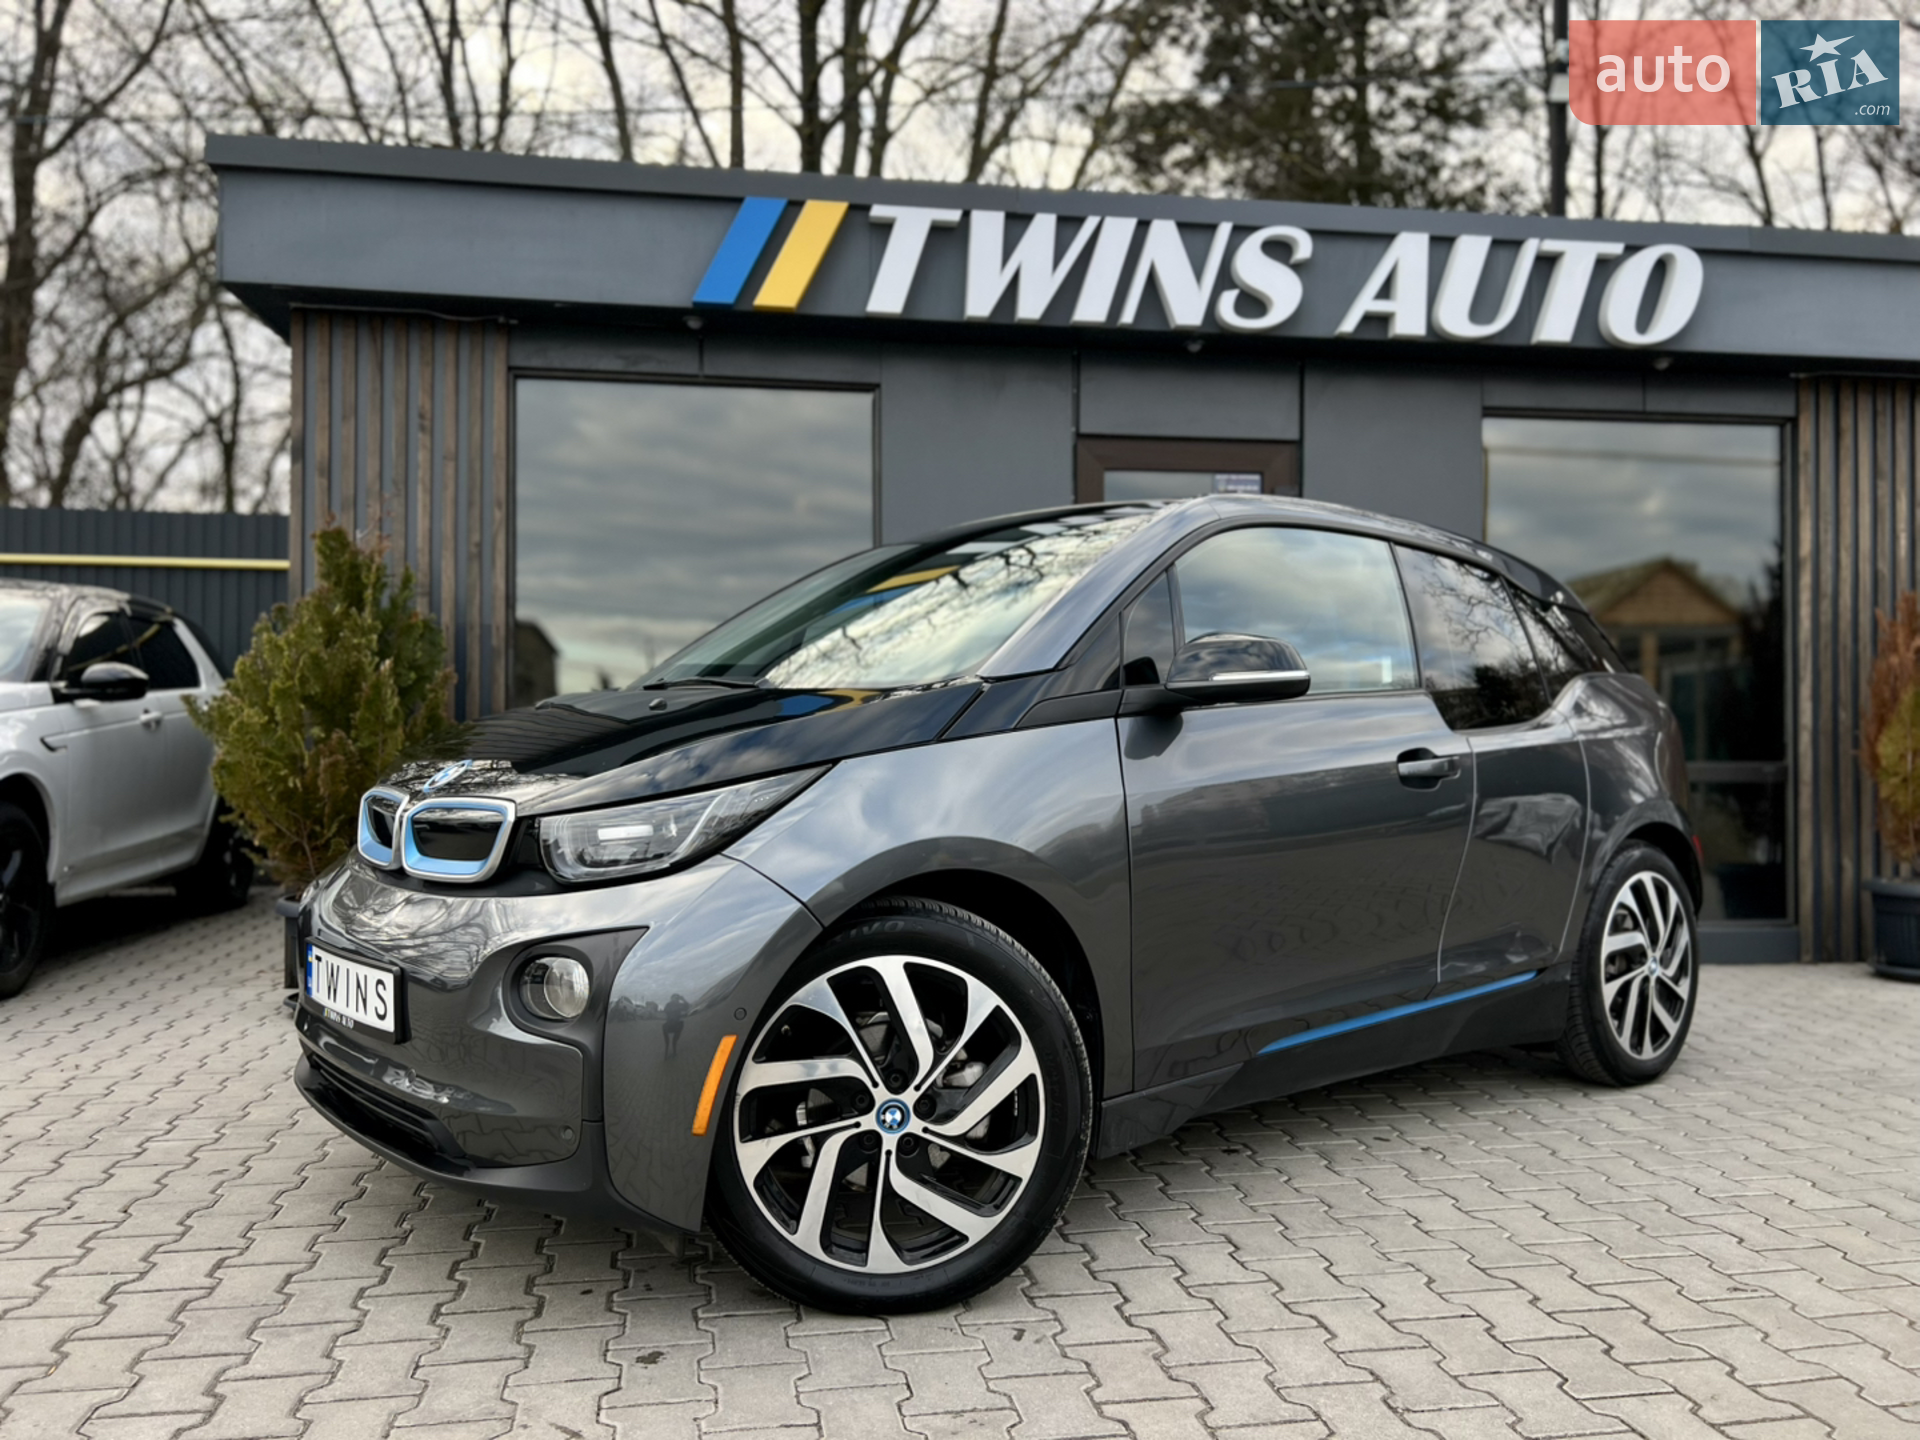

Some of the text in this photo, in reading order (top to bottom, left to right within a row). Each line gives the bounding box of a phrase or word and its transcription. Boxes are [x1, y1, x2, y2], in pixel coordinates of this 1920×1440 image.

[865, 203, 1704, 349] TWINS AUTO
[315, 953, 388, 1021] TWINS
